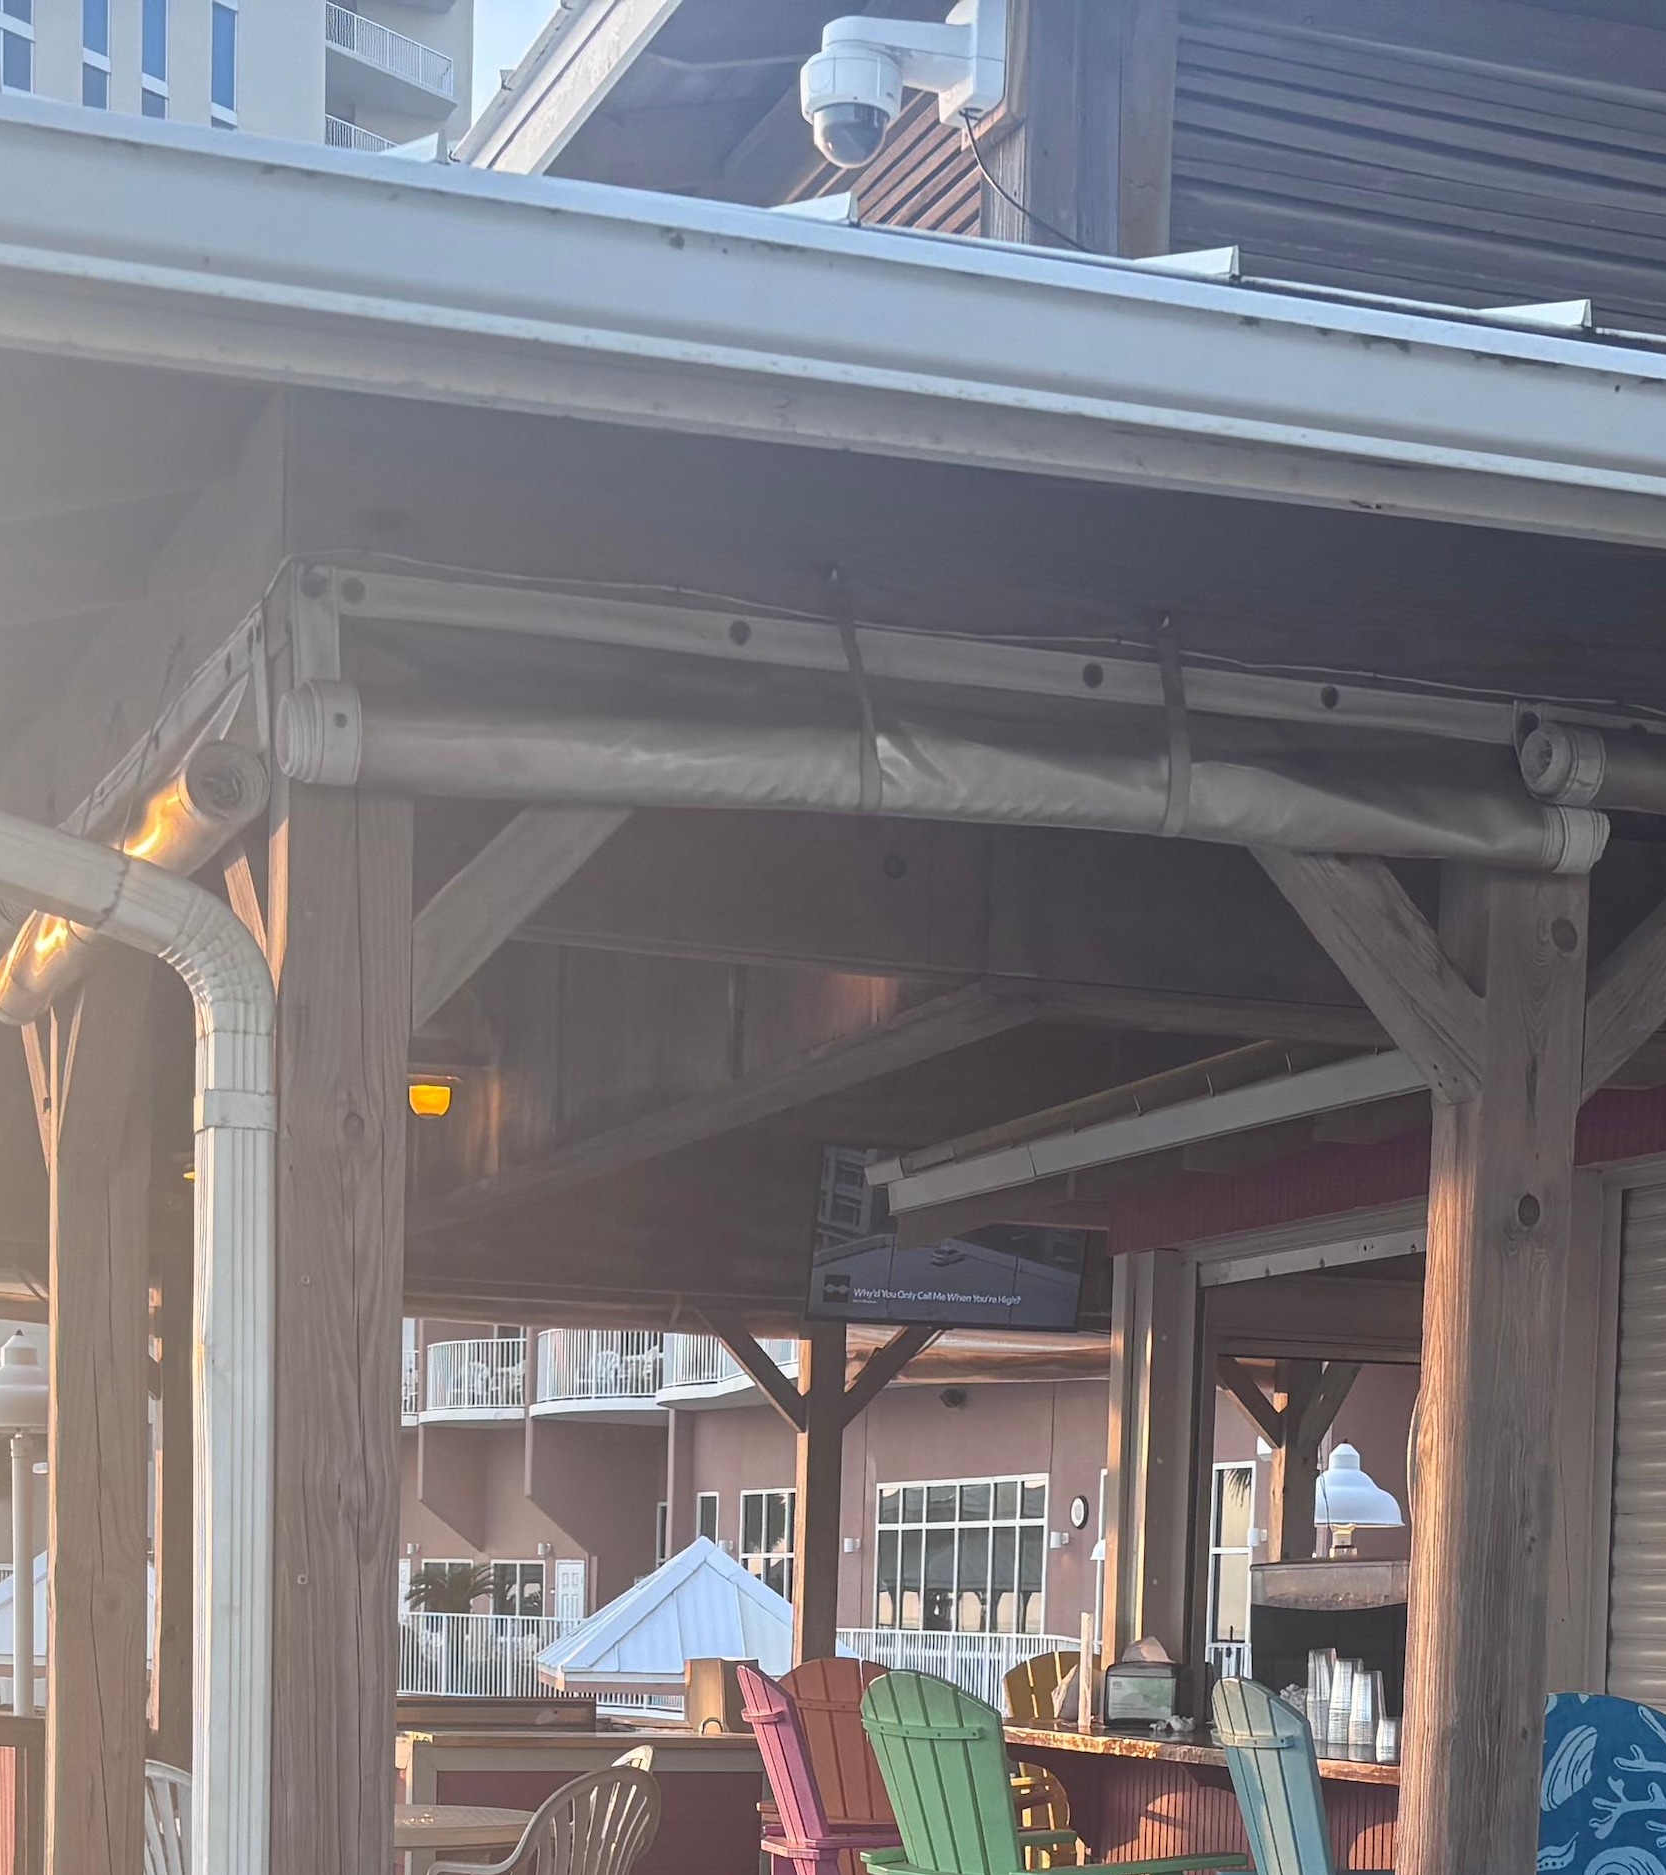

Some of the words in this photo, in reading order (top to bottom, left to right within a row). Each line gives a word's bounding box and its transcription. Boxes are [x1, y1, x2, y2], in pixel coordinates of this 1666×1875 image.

[881, 1288, 897, 1299] You
[897, 1290, 916, 1302] Only
[917, 1291, 932, 1300] Call
[933, 1291, 946, 1301] Me
[947, 1292, 972, 1303] When
